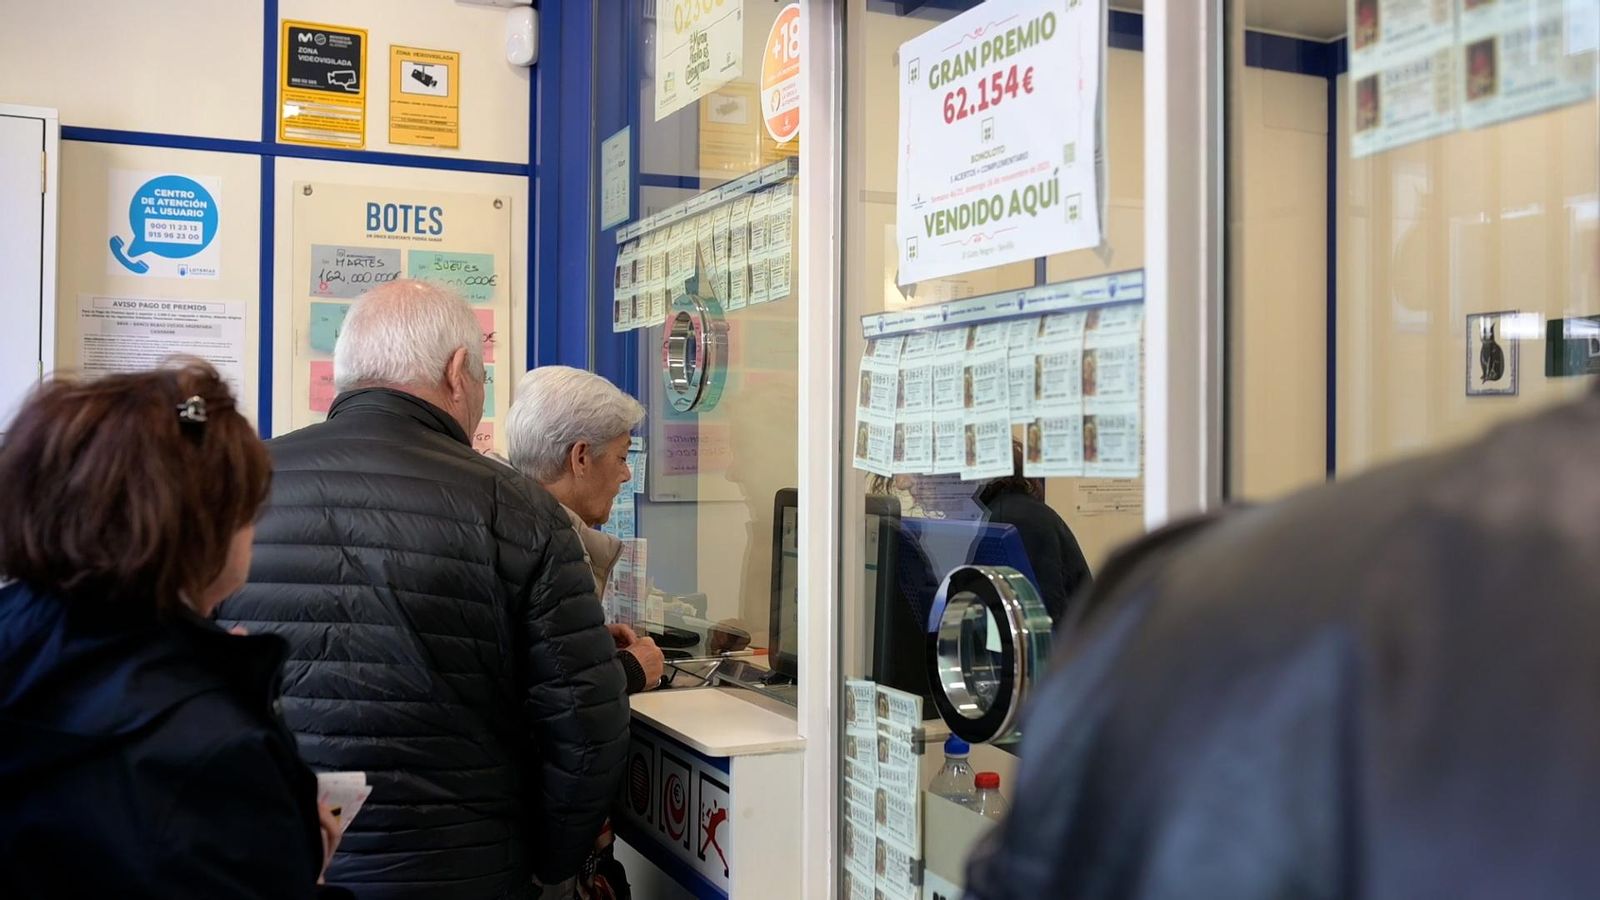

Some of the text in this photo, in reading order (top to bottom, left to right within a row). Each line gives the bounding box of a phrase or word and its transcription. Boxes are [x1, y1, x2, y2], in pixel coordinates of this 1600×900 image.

[298, 47, 318, 55] ZONA
[928, 11, 1057, 90] GRAN PREMIO
[298, 55, 352, 66] VIDEOVIGILADA
[154, 189, 195, 199] CENTRO
[141, 197, 207, 208] DE ATENCIÓN
[924, 167, 1059, 238] VENDIDO AQUÍ
[144, 206, 204, 217] AL USUARIO
[367, 202, 443, 235] BOTES
[150, 222, 167, 230] 900
[169, 223, 176, 231] 11
[335, 257, 385, 268] MARTES
[161, 302, 171, 310] DE
[173, 303, 207, 311] PREMIOS
